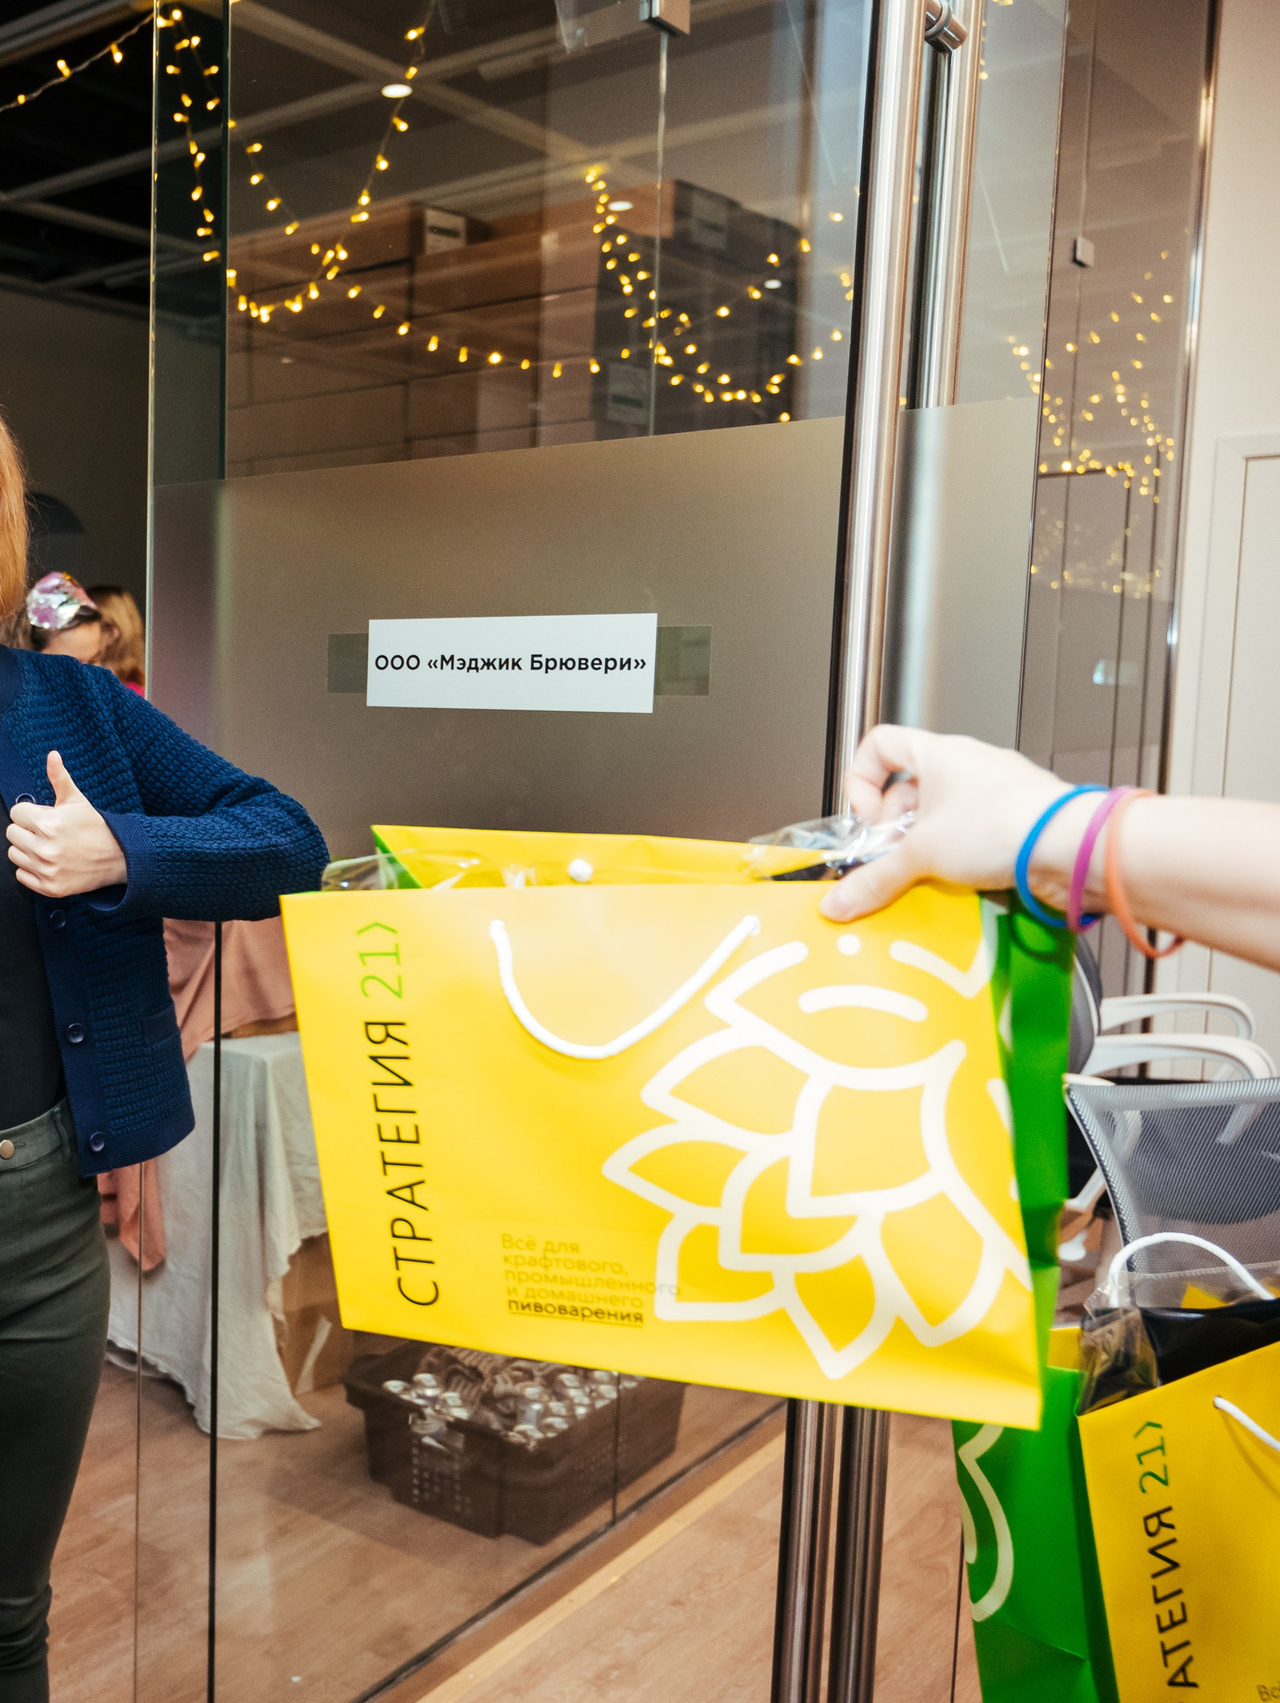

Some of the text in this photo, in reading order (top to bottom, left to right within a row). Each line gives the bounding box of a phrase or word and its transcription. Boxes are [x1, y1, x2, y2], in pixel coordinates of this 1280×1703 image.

[374, 653, 647, 675] ООО «Мэджик Брювери»
[364, 1021, 440, 1307] СТРАТЕГИЯ
[500, 1232, 581, 1255] Всё для
[502, 1253, 630, 1277] крафтового,
[504, 1268, 683, 1297] промышленного
[506, 1286, 645, 1310] и домашнего
[507, 1299, 645, 1325] пивоварения
[1142, 1505, 1200, 1690] АТЕГИЯ
